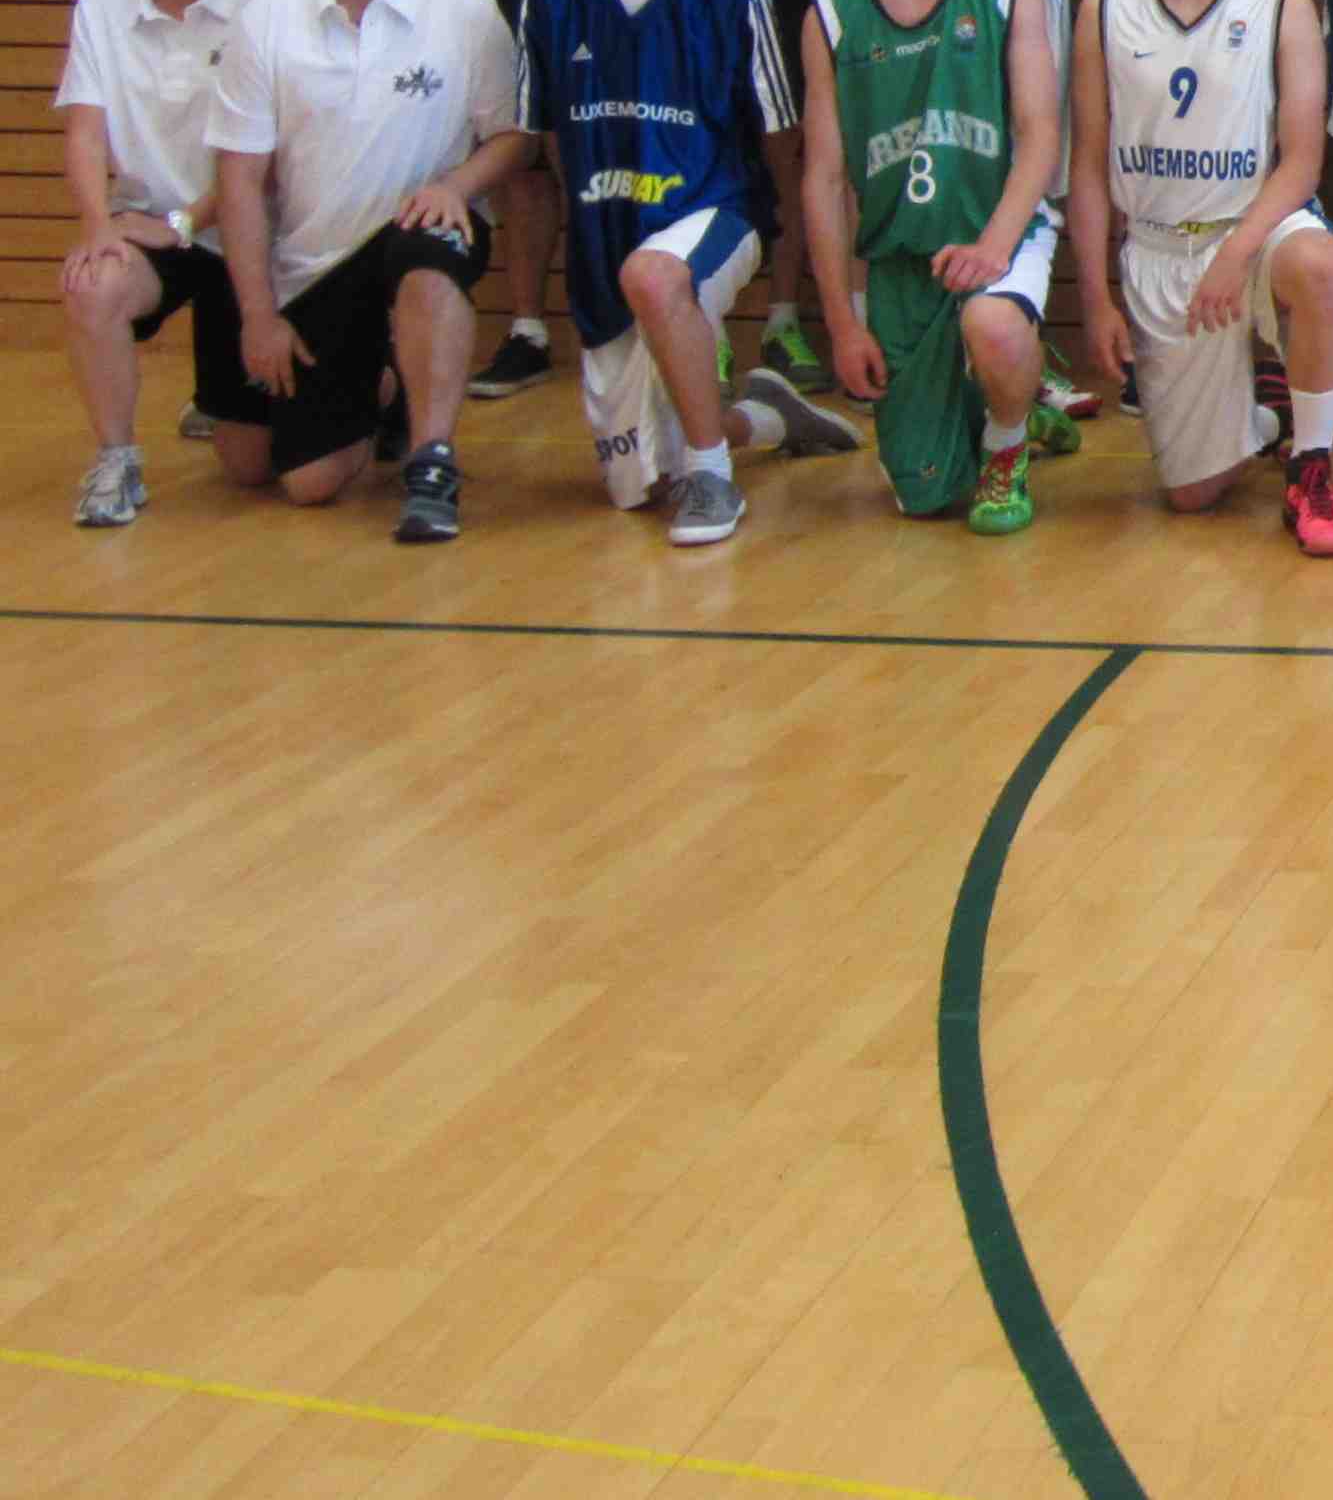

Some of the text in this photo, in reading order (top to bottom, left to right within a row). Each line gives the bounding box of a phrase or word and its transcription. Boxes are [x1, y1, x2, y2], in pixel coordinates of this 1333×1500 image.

[570, 101, 696, 127] LUXEMOURG
[1169, 66, 1199, 119] 9
[907, 149, 937, 204] 8
